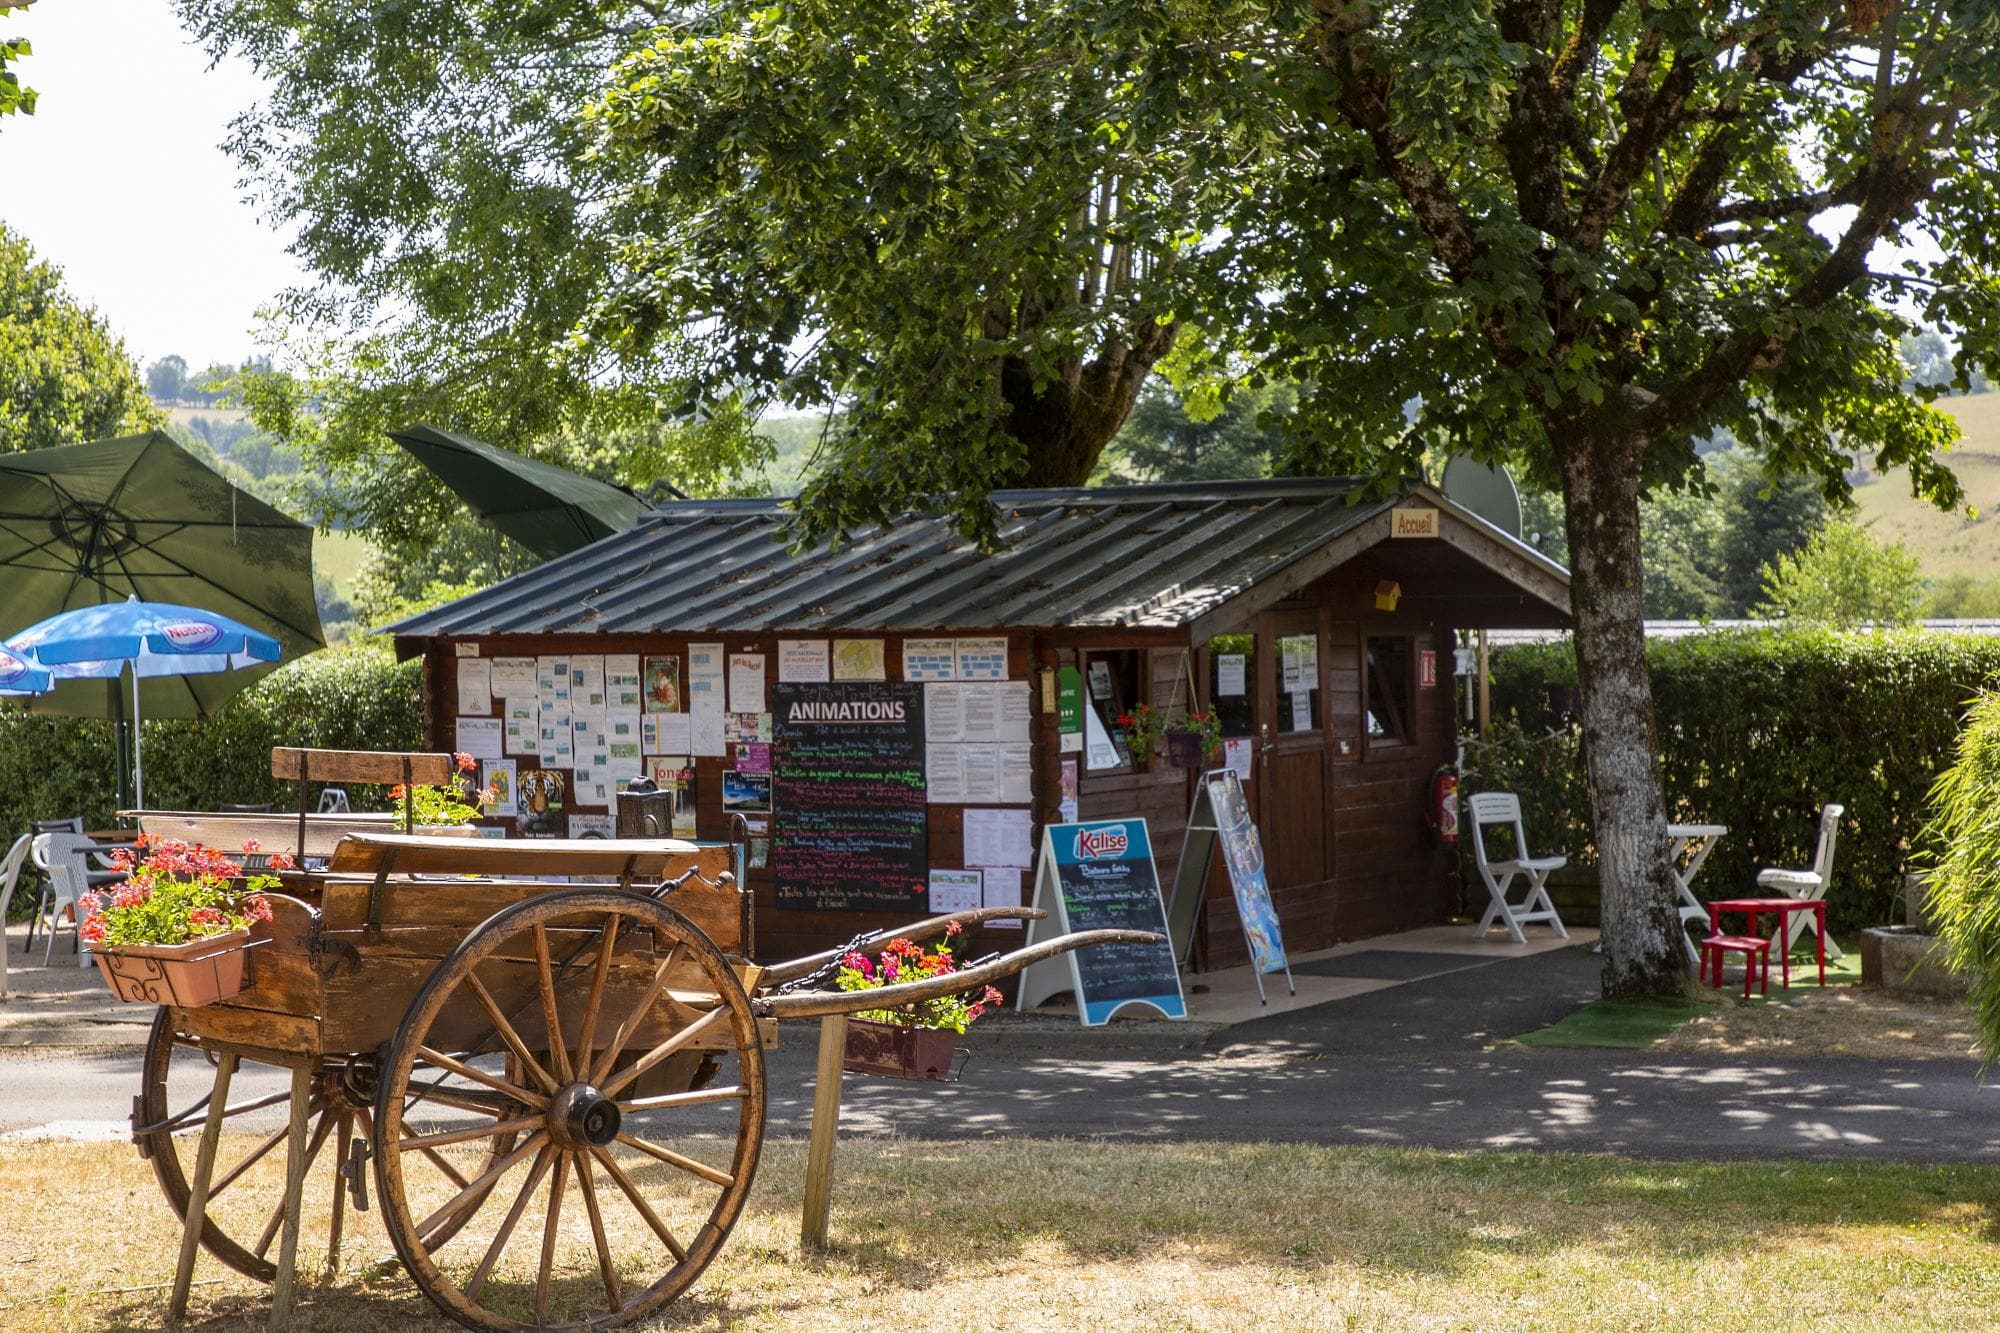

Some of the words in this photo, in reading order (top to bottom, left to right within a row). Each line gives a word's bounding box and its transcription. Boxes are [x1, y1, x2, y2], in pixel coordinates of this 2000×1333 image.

[1398, 512, 1432, 534] Accueil
[788, 701, 906, 720] ANIMATIONS
[1079, 829, 1127, 858] Kalise
